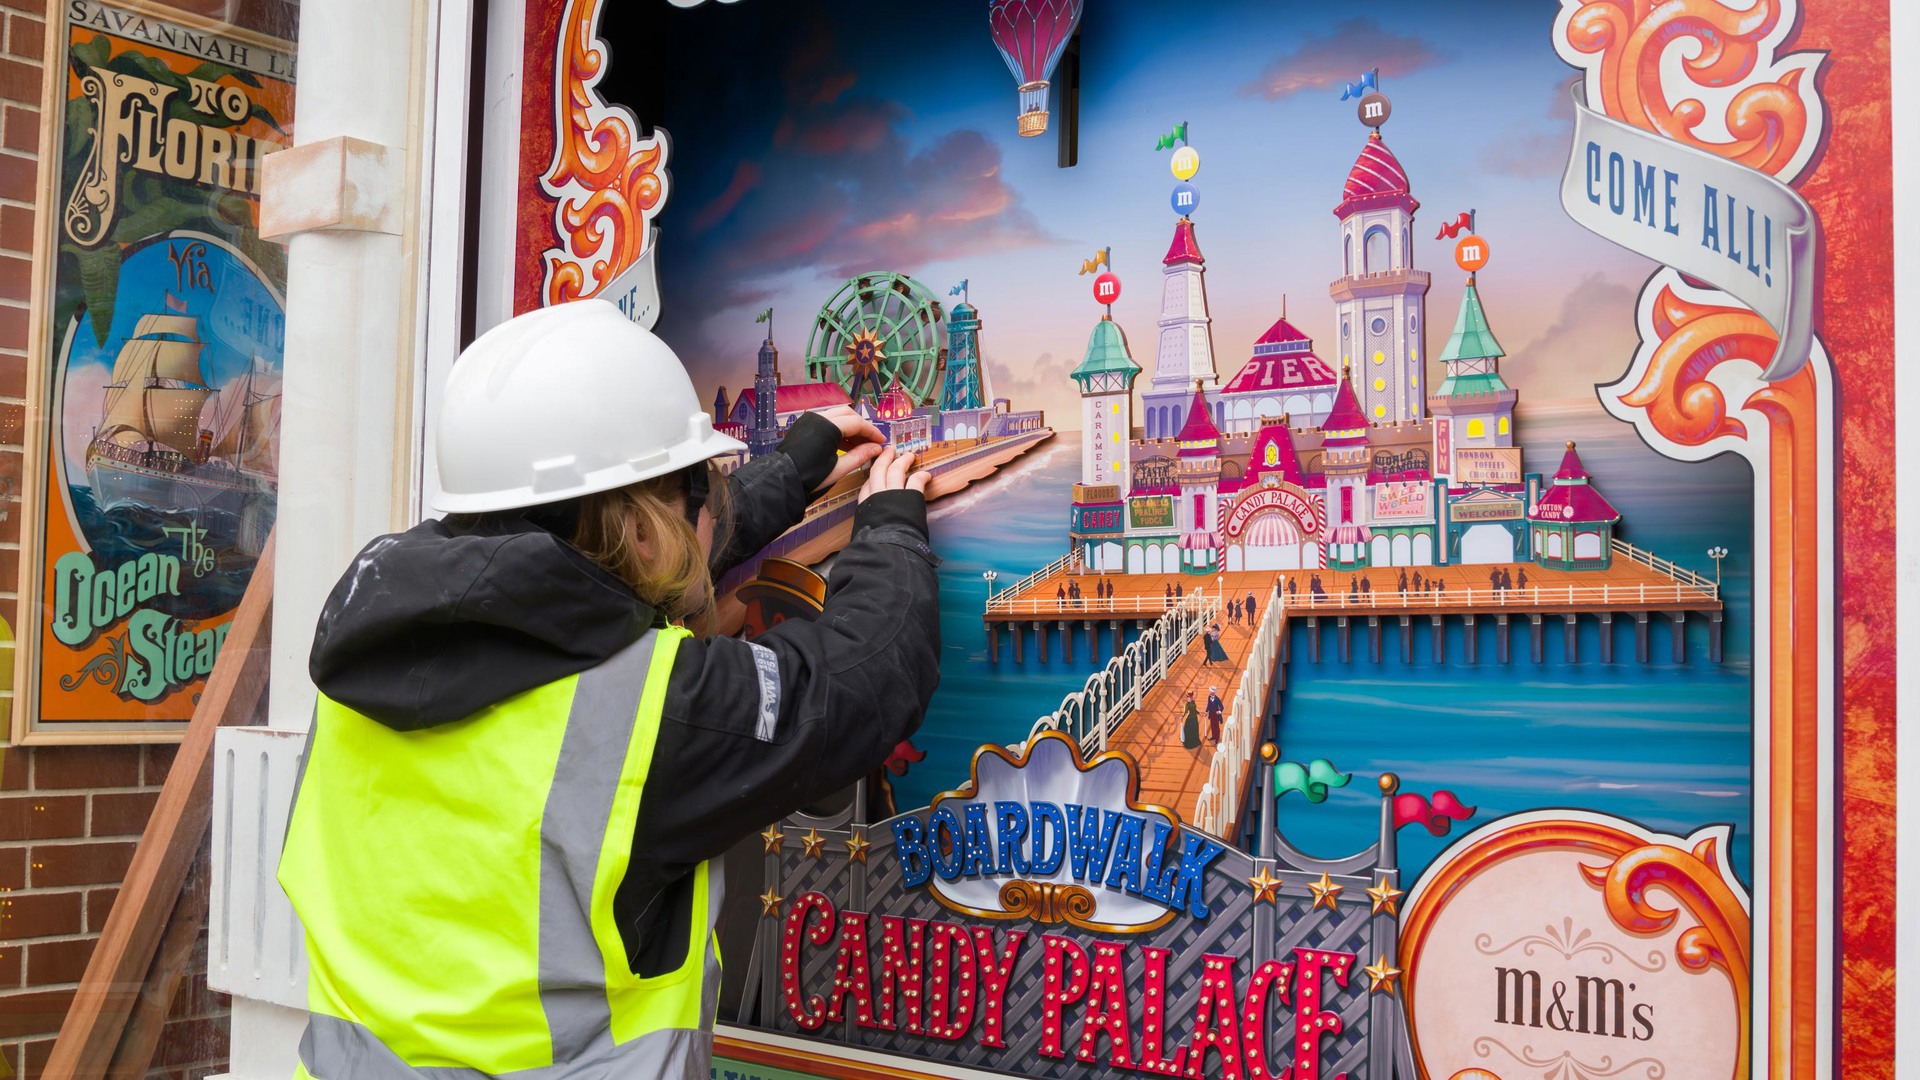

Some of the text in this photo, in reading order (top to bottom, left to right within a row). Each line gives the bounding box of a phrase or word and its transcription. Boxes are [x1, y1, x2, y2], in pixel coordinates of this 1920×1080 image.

[69, 0, 249, 67] SAVANNAH
[187, 77, 249, 121] TO
[1364, 100, 1383, 118] m
[1177, 155, 1193, 171] m
[1177, 190, 1193, 206] m
[1586, 141, 1772, 288] COME ALL!
[1462, 245, 1481, 262] m
[168, 242, 215, 294] Via
[1099, 279, 1115, 296] m
[1229, 356, 1338, 389] PIER
[1095, 401, 1103, 482] CARAMELS
[1438, 421, 1448, 471] FUN
[1375, 451, 1412, 465] WORLD
[1458, 451, 1494, 459] BONBONS
[1383, 460, 1428, 474] FAMOUS
[1475, 461, 1505, 469] TOFFEES
[1469, 470, 1518, 480] CHOCOLATES
[1132, 498, 1169, 508] CARAMELS
[1236, 491, 1309, 520] CANDY PALACE
[1540, 503, 1562, 511] COTTON
[1083, 510, 1120, 528] CANDY
[1134, 507, 1168, 517] PRALINES
[1140, 516, 1163, 525] FUDGE
[1459, 509, 1517, 519] WELCOME!
[162, 520, 215, 578] The
[52, 551, 181, 645] Ocean
[891, 799, 1225, 919] BOARDWALK
[781, 891, 1356, 1080] CANDY PALACE
